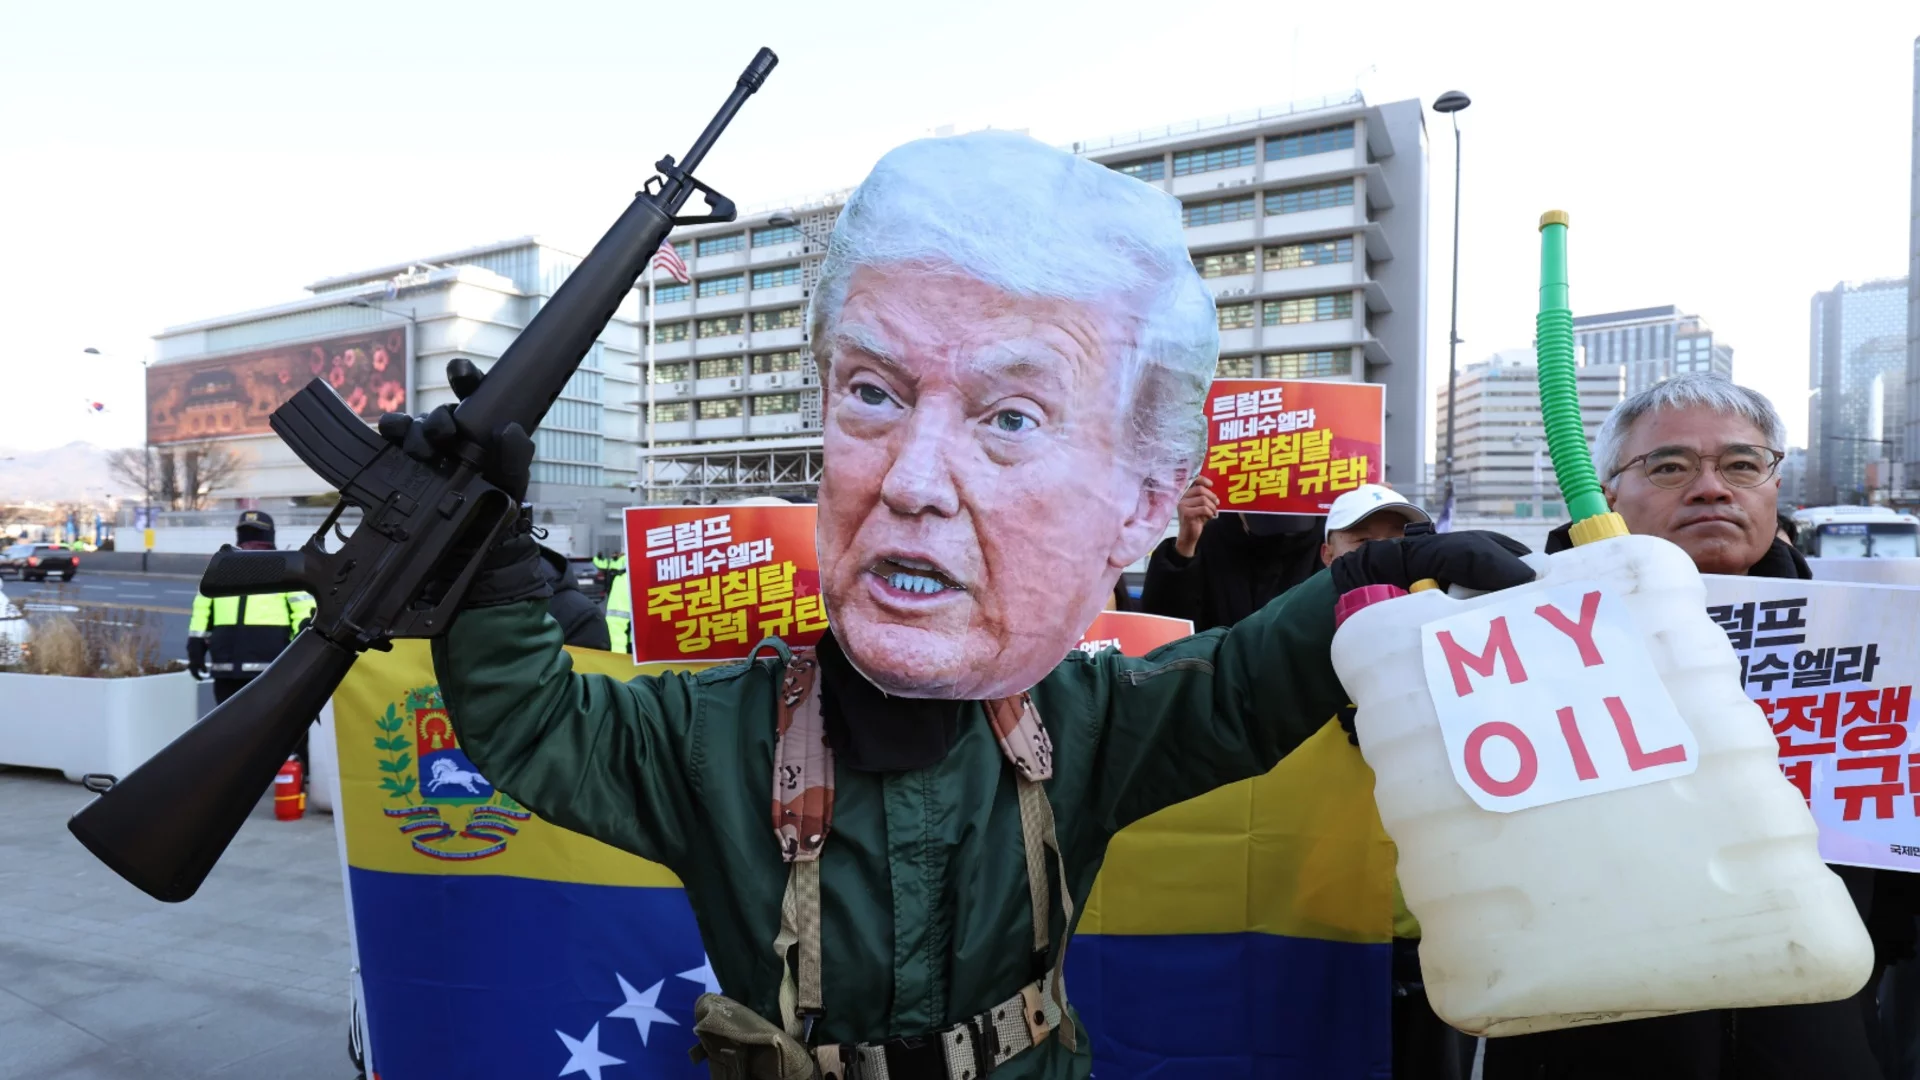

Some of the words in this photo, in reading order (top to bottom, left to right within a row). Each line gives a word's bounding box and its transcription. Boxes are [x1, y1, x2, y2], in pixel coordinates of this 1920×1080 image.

[1212, 387, 1283, 421] 트럼프
[1219, 408, 1316, 441] 베네수엘라
[1208, 428, 1333, 475] 주권침탈
[1228, 467, 1289, 505] 강력
[645, 514, 732, 558] 트럼프
[657, 537, 774, 582] 베네수엘라
[647, 560, 797, 622] 주권침탈
[675, 609, 749, 654] 강력
[1435, 590, 1605, 698] MY
[1740, 644, 1881, 692] 수엘라
[1754, 685, 1912, 758] 전쟁
[1463, 696, 1688, 798] OIL
[1834, 752, 1920, 821] 규
